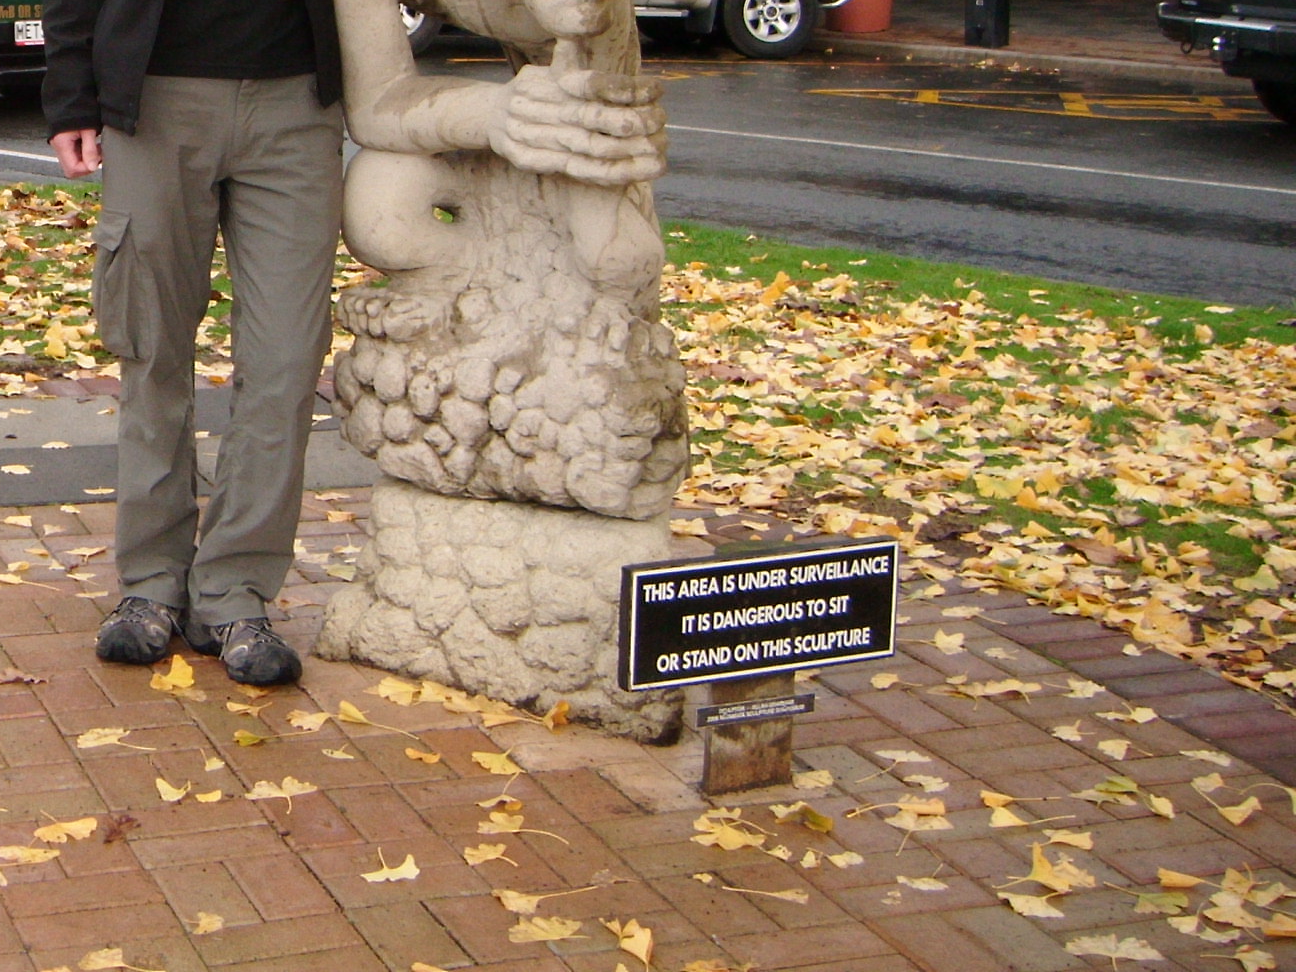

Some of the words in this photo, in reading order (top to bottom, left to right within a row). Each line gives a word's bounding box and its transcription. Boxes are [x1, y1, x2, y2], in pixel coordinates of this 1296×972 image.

[18, 4, 31, 18] OR
[34, 3, 44, 18] S
[15, 23, 43, 40] MET
[643, 582, 675, 603] THIS
[677, 575, 719, 599] AREA
[722, 573, 736, 593] IS
[738, 568, 787, 591] UNDER
[789, 555, 889, 584] SURVEILLANCE
[681, 615, 696, 634] IT
[697, 613, 711, 632] IS
[713, 602, 804, 630] DANGEROUS
[806, 598, 827, 618] TO
[829, 595, 850, 615] SIT
[656, 653, 680, 673] OR
[682, 646, 731, 671] STAND
[734, 642, 759, 662] ON
[761, 638, 792, 659] THIS
[794, 627, 870, 655] SCULPTURE
